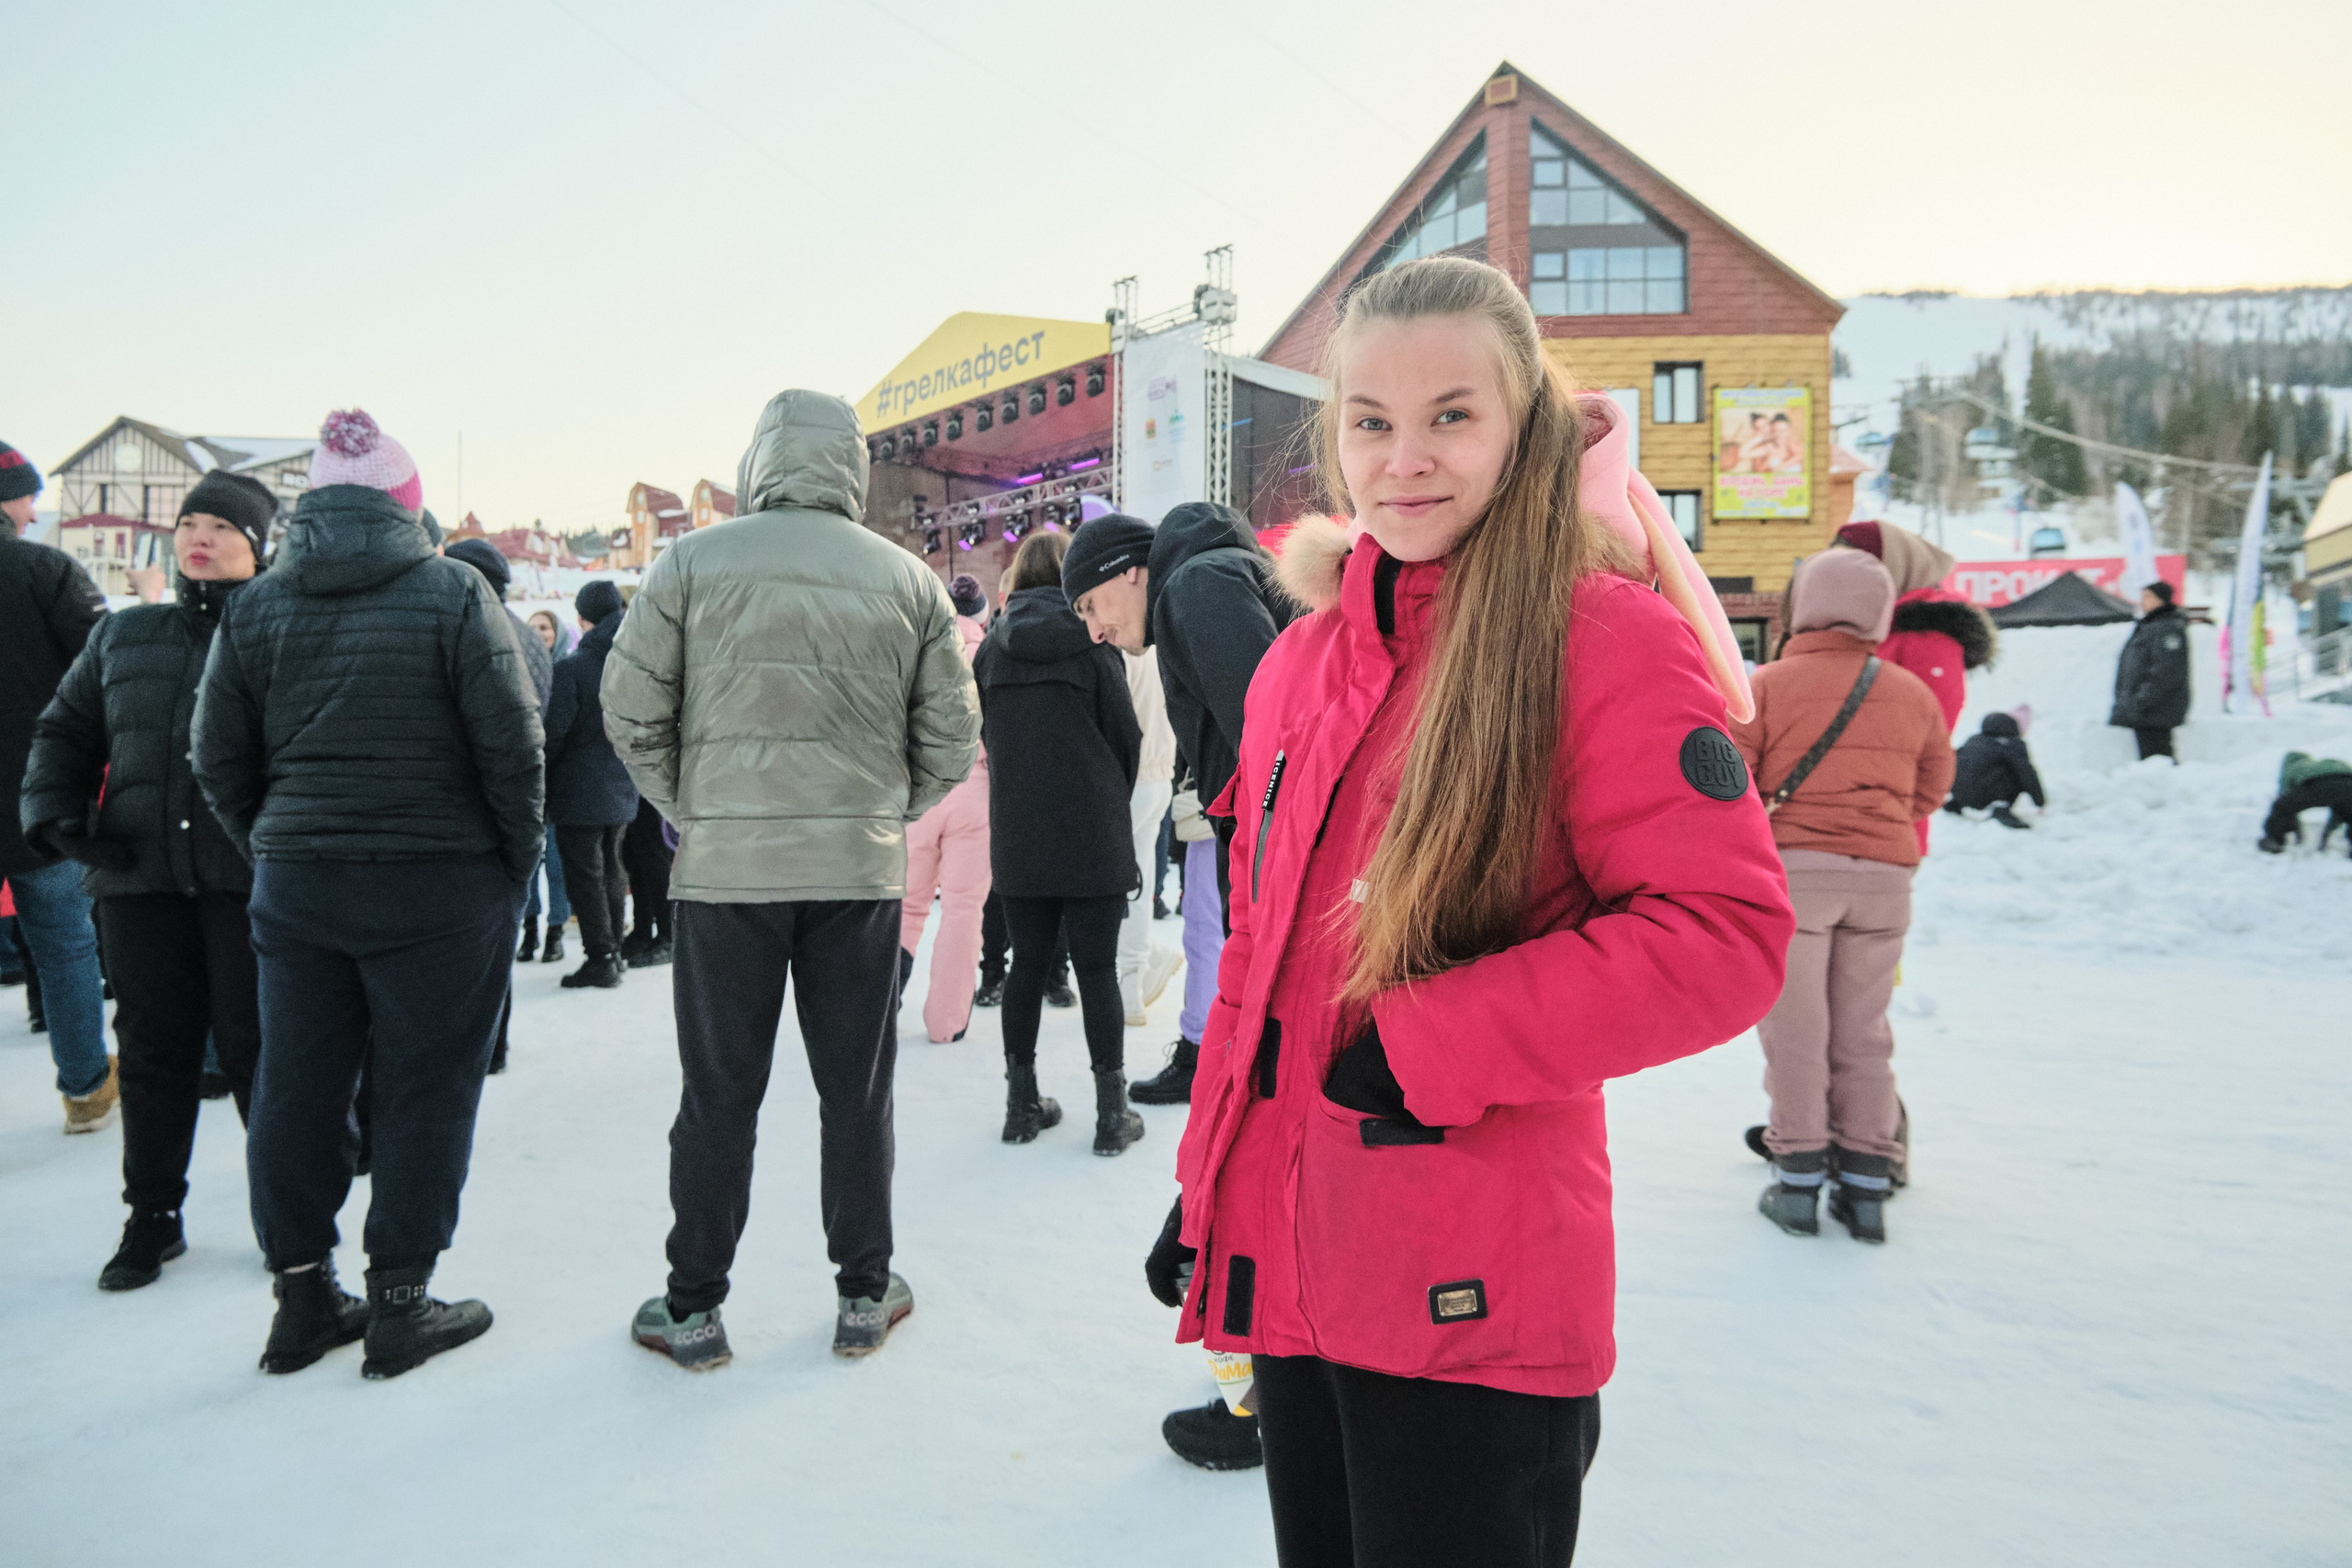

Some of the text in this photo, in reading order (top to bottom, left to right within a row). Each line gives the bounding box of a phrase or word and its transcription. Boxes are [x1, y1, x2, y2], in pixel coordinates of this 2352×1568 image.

[876, 330, 1045, 418] #грелкафест
[1694, 736, 1736, 764] BIG
[1695, 761, 1740, 789] GUY
[845, 1309, 885, 1326] ecco
